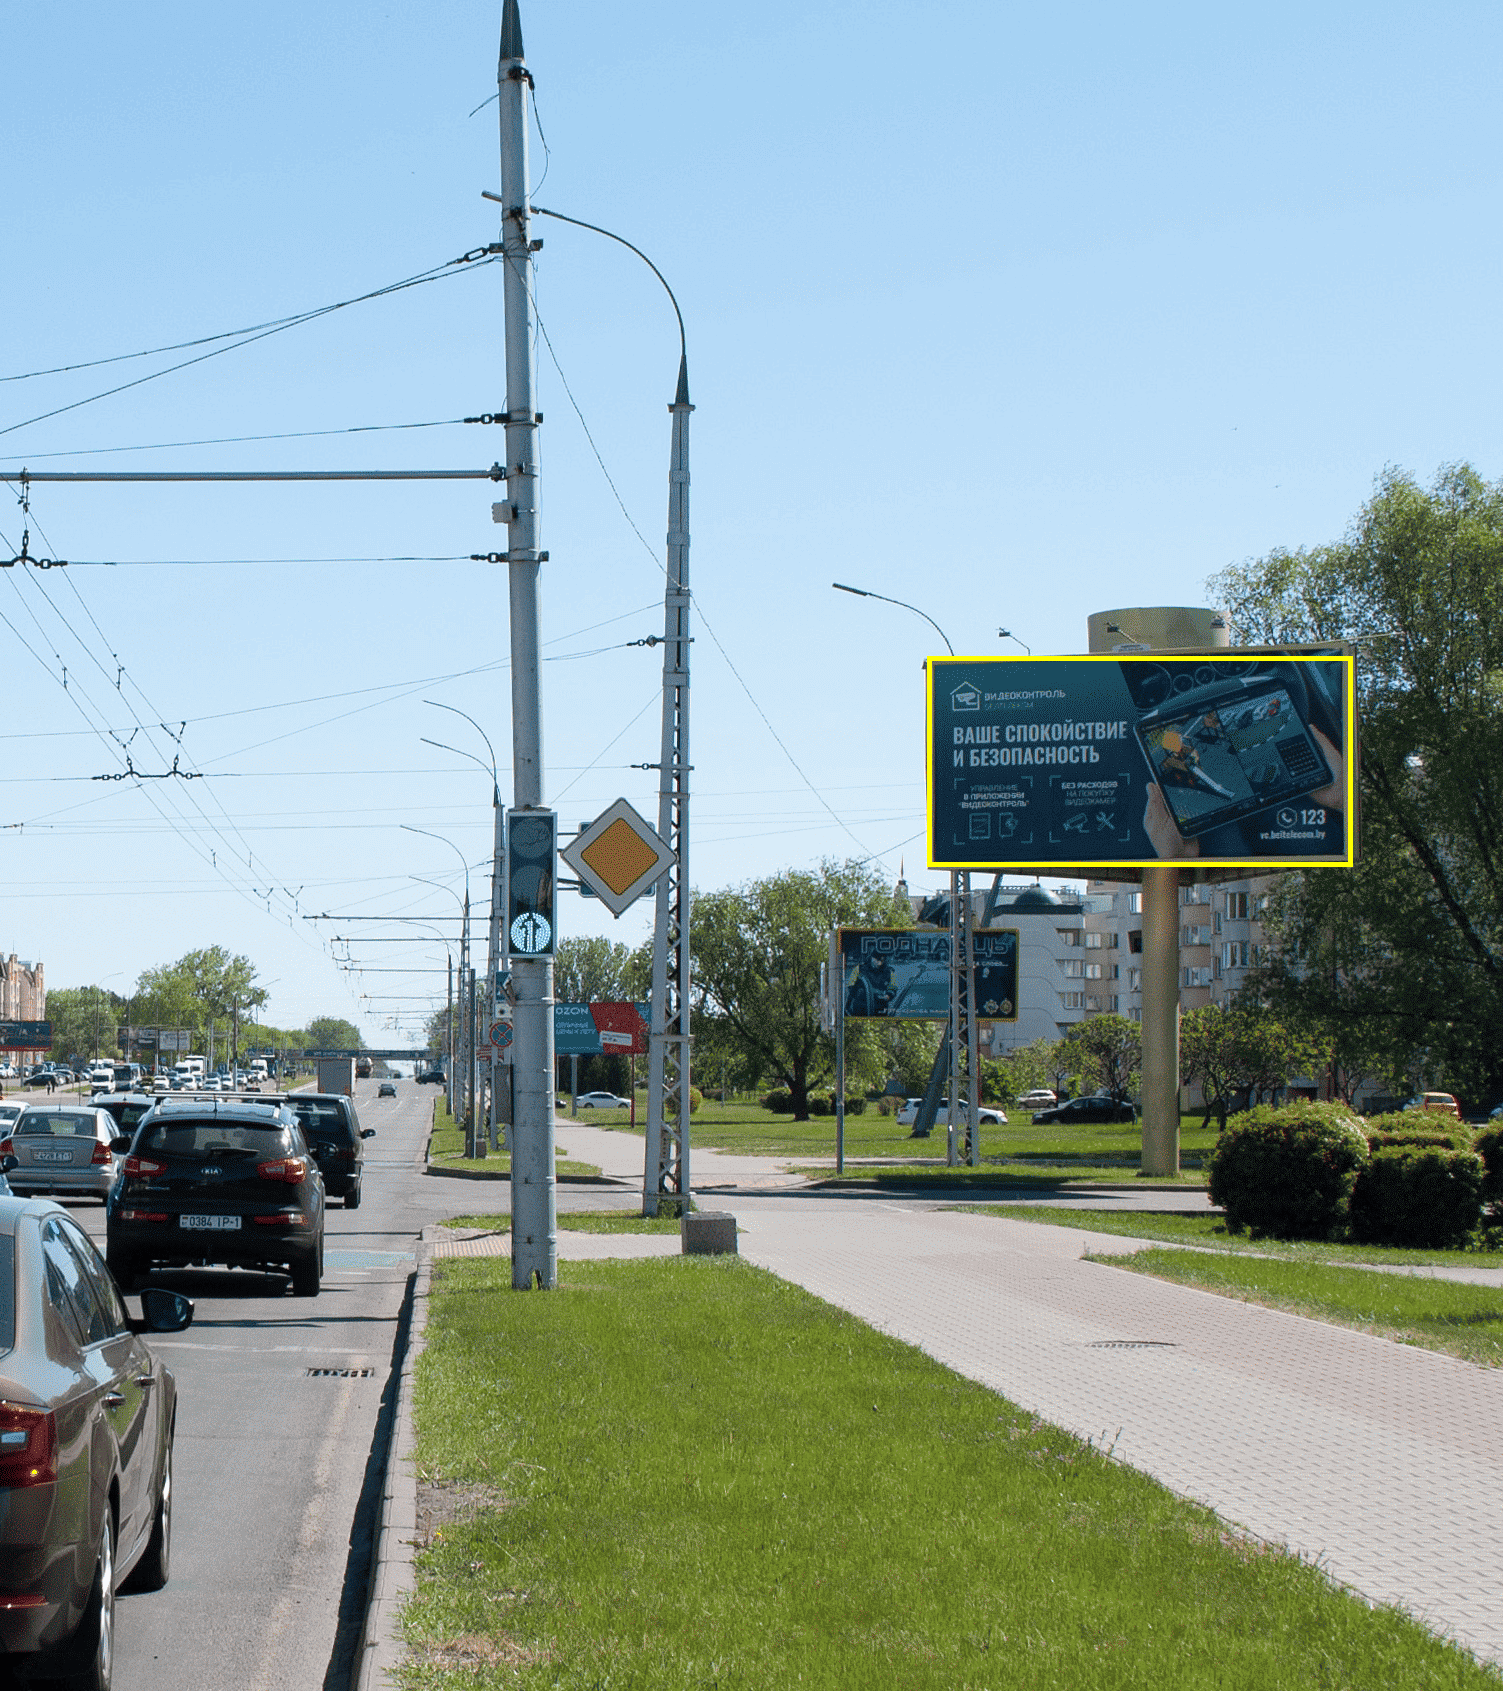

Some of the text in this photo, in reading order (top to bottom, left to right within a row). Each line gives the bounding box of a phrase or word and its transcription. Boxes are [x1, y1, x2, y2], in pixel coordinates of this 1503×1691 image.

[984, 690, 1066, 701] ВИДЕОКОНТРОЛЬ
[953, 719, 1127, 744] ВАШЕ СПОКОЙСТВИЕ
[953, 745, 1100, 767] И БЕЗОПАСНОСТЬ
[1300, 809, 1326, 825] 123
[555, 1007, 589, 1015] OZON
